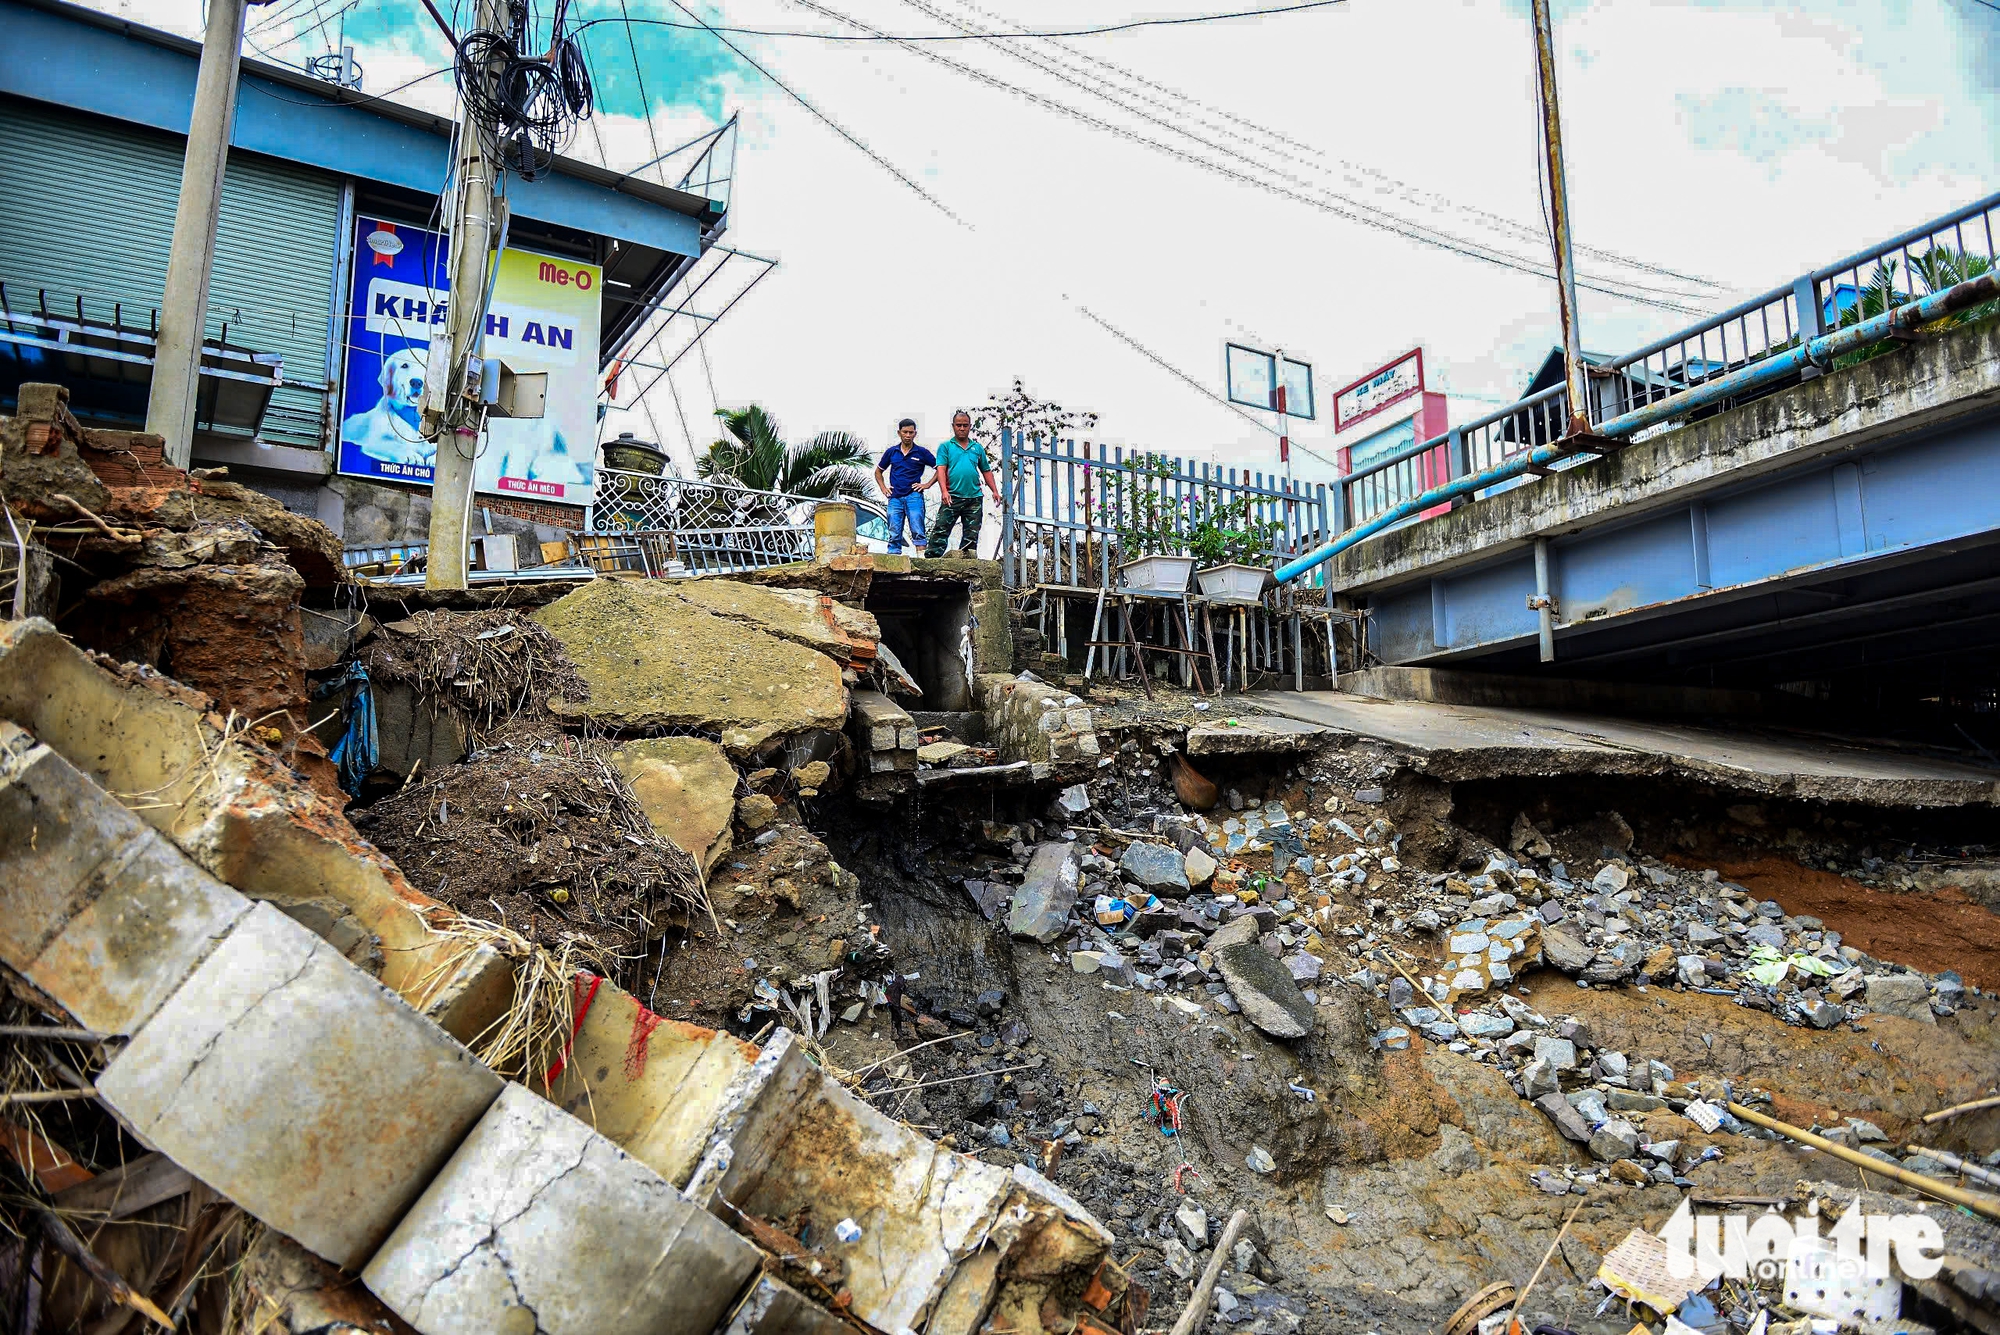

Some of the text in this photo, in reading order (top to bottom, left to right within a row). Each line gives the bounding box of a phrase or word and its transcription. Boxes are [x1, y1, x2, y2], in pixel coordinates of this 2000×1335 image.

[538, 262, 592, 291] Me-O
[374, 292, 573, 350] KHÁH AN
[380, 463, 430, 478] THỨC ĂN CHÓ
[507, 480, 526, 491] THỨC
